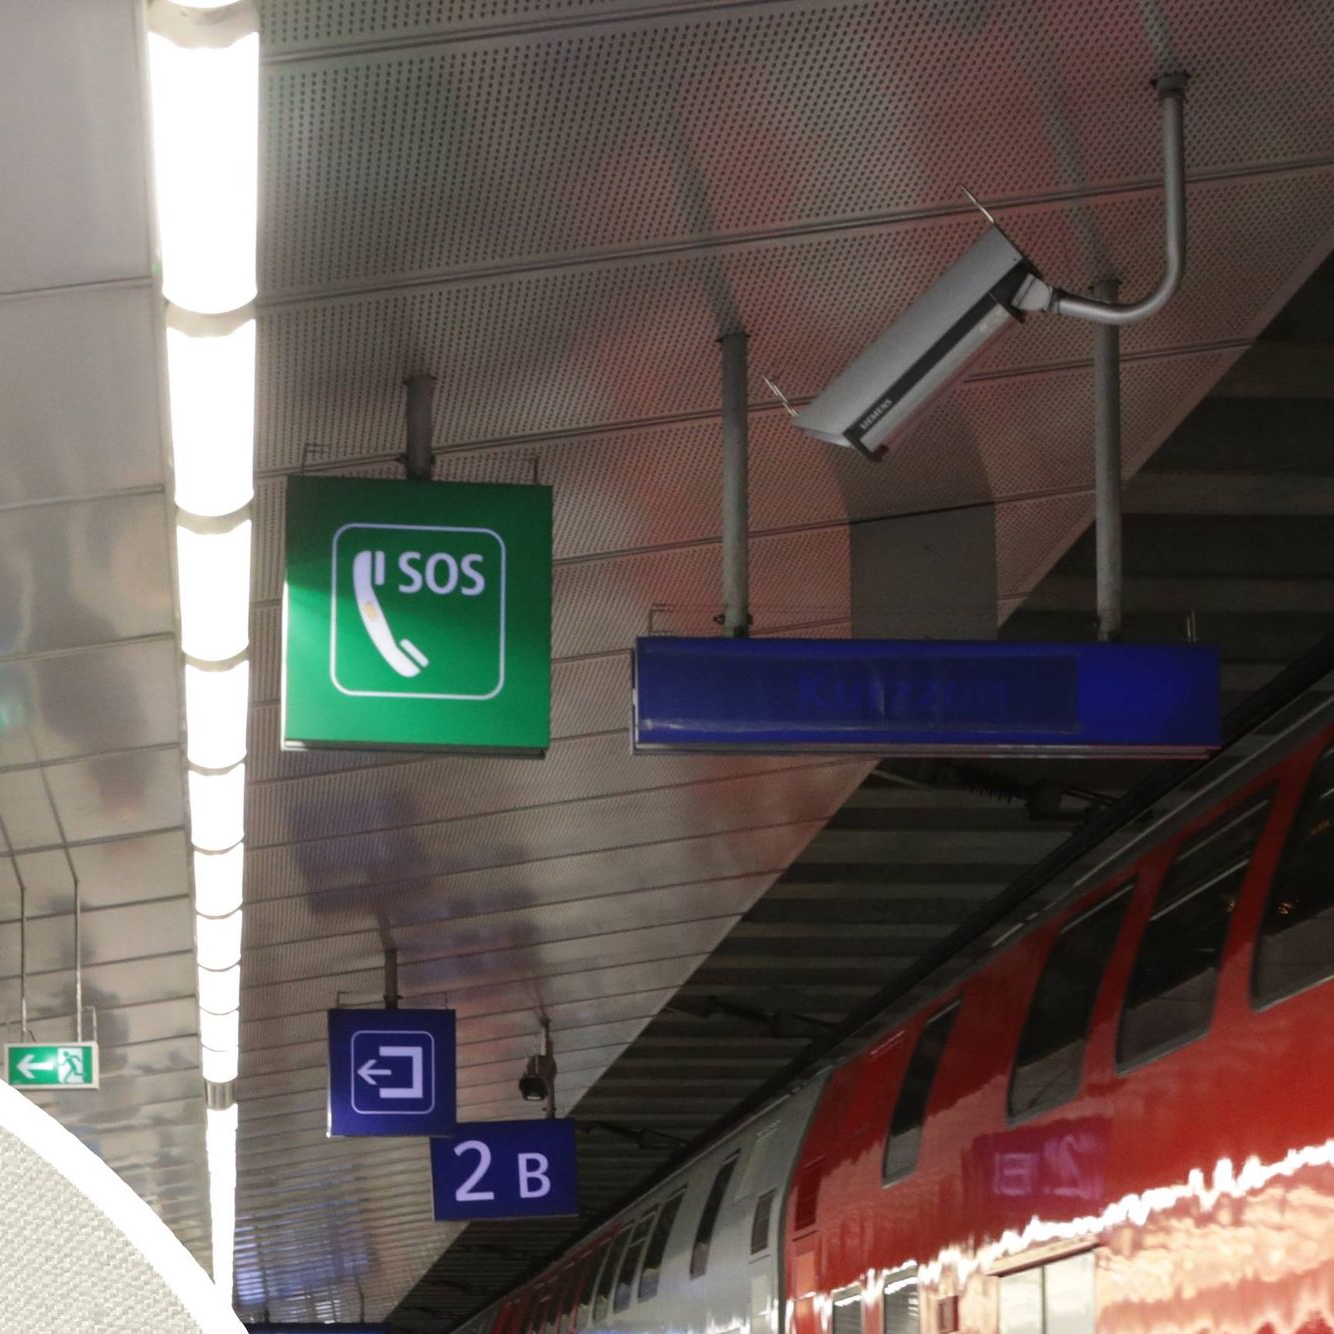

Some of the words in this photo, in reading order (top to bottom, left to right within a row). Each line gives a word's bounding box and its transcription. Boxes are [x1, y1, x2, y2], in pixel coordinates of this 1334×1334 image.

[398, 551, 486, 596] SOS
[454, 1139, 495, 1202] 2
[517, 1152, 551, 1199] B
